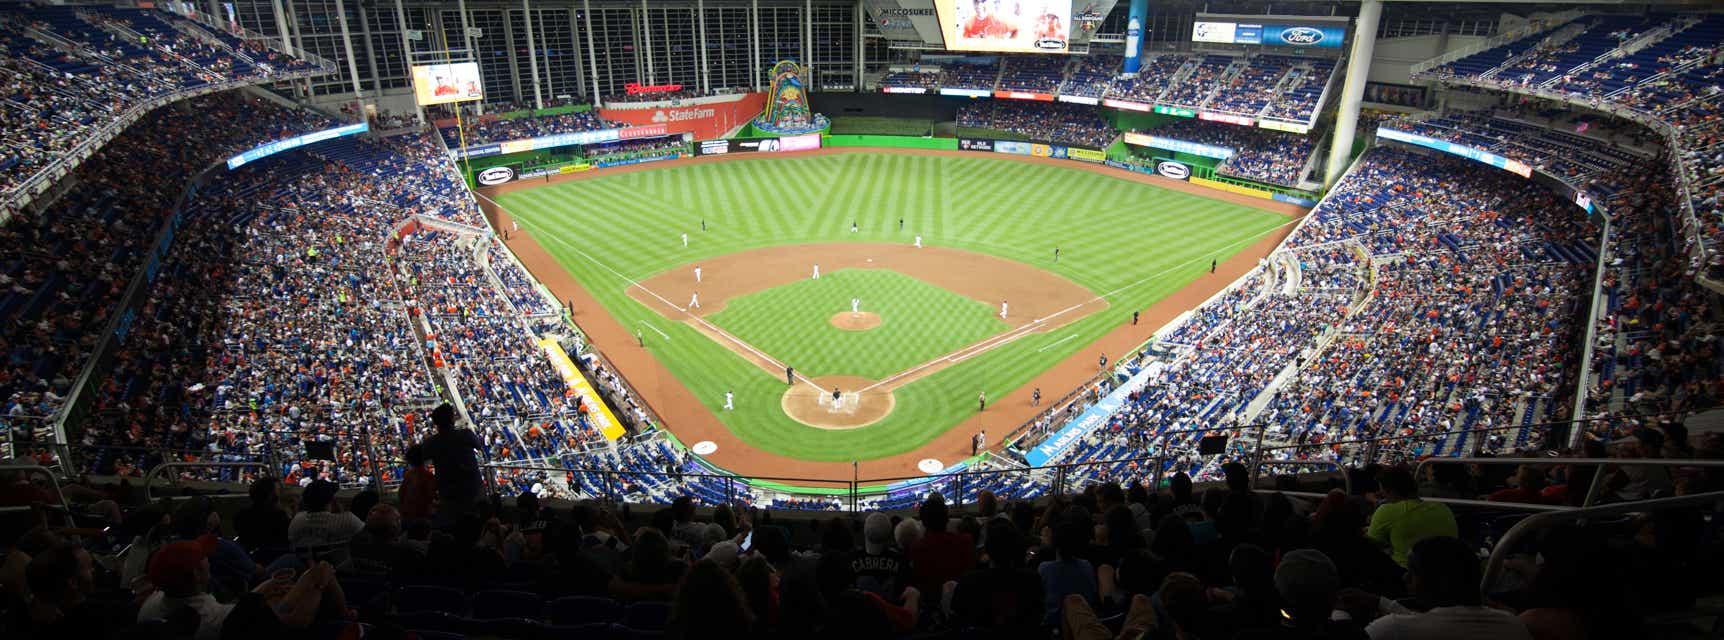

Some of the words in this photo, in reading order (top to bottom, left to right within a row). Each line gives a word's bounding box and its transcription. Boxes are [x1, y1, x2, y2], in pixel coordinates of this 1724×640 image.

[880, 8, 934, 16] MICCOSUKEE
[1287, 30, 1314, 42] Ford
[851, 557, 898, 573] CABRERA
